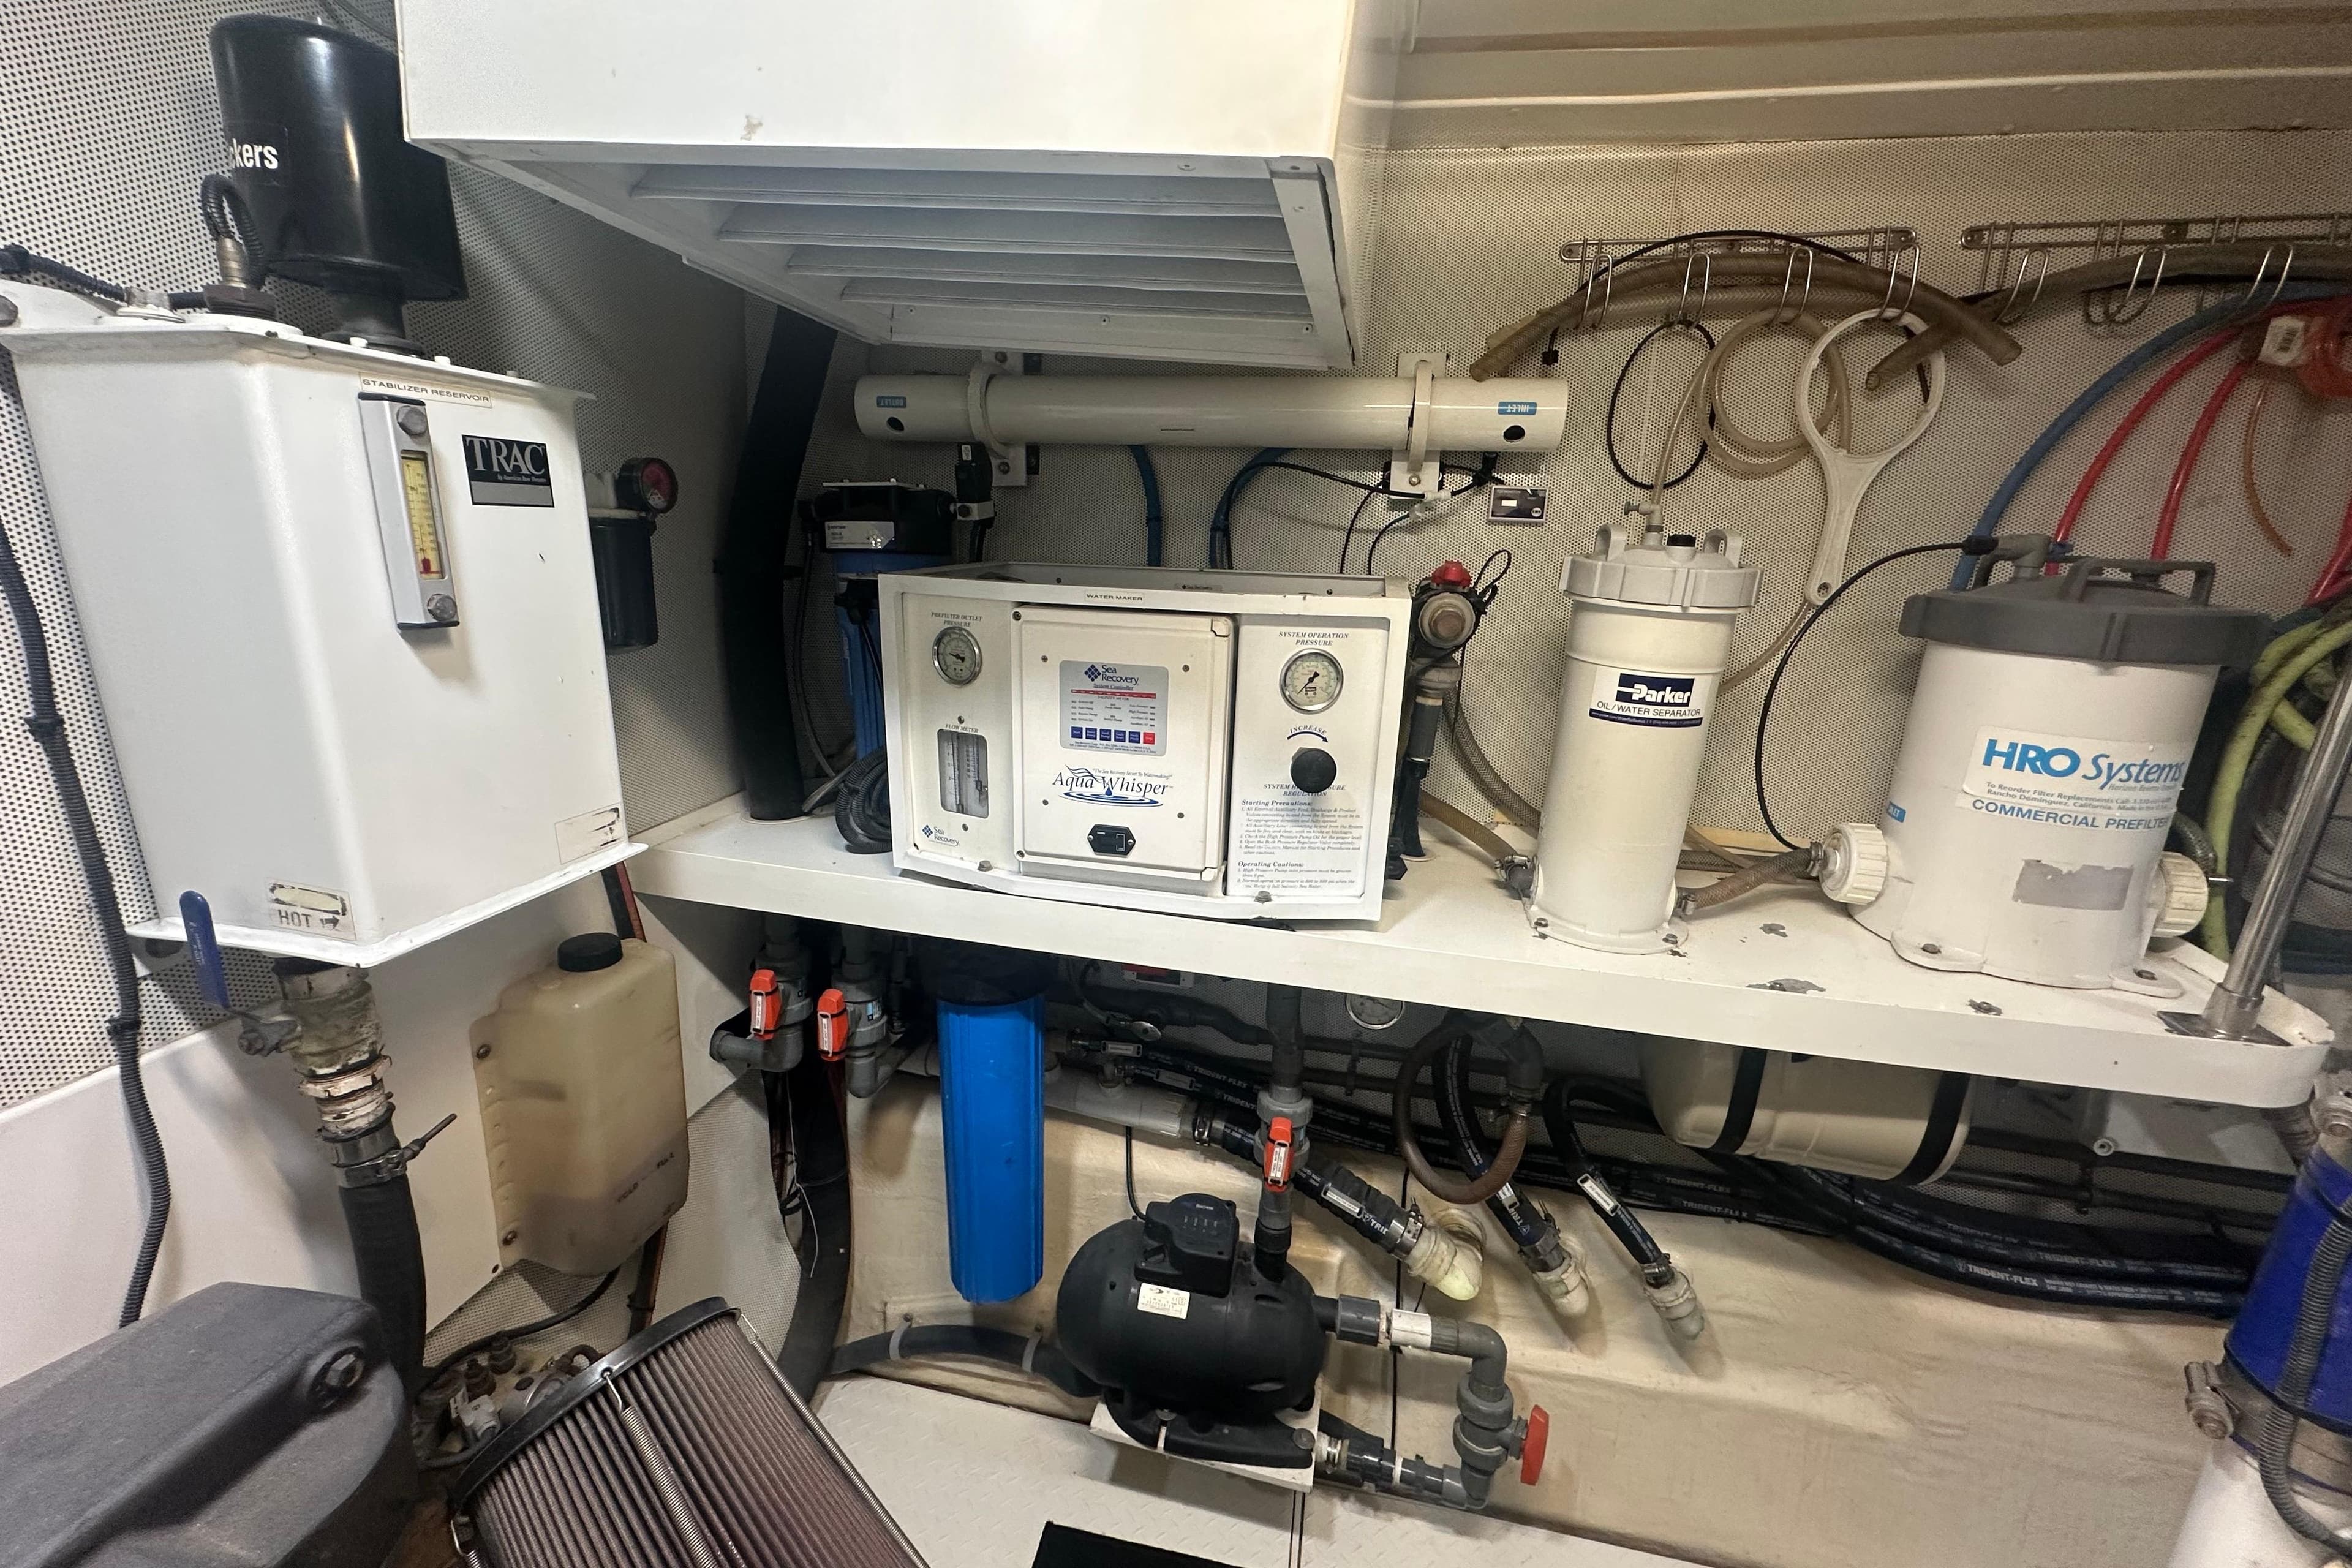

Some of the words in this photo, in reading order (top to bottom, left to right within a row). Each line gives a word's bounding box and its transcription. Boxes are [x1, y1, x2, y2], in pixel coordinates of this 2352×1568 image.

[363, 379, 428, 394] STABILIZER
[431, 389, 489, 402] RESERVOIR
[466, 437, 546, 475] TRAC
[1102, 665, 1117, 674] Sea
[1102, 673, 1139, 686] Recovery
[1631, 683, 1691, 704] Parker
[1652, 708, 1701, 717] SEPARATOR
[1289, 725, 1327, 736] INCREASE
[1982, 738, 2081, 778] HRO
[2082, 753, 2188, 790] Systems
[1052, 772, 1095, 791] Aqua
[1101, 776, 1169, 799] Whisper
[1987, 789, 2016, 799] Rancho
[1998, 783, 2030, 794] Reorder
[2033, 790, 2055, 798] Filter
[2057, 793, 2113, 804] Replacements
[1972, 799, 2100, 828] COMMERCIAL
[933, 826, 944, 835] Sea
[934, 834, 960, 846] Recovery
[277, 909, 312, 927] HOT
[1683, 1200, 1749, 1218] TRIDENT-FLEX
[1967, 1264, 2038, 1287] TRIDENT-FLEX
